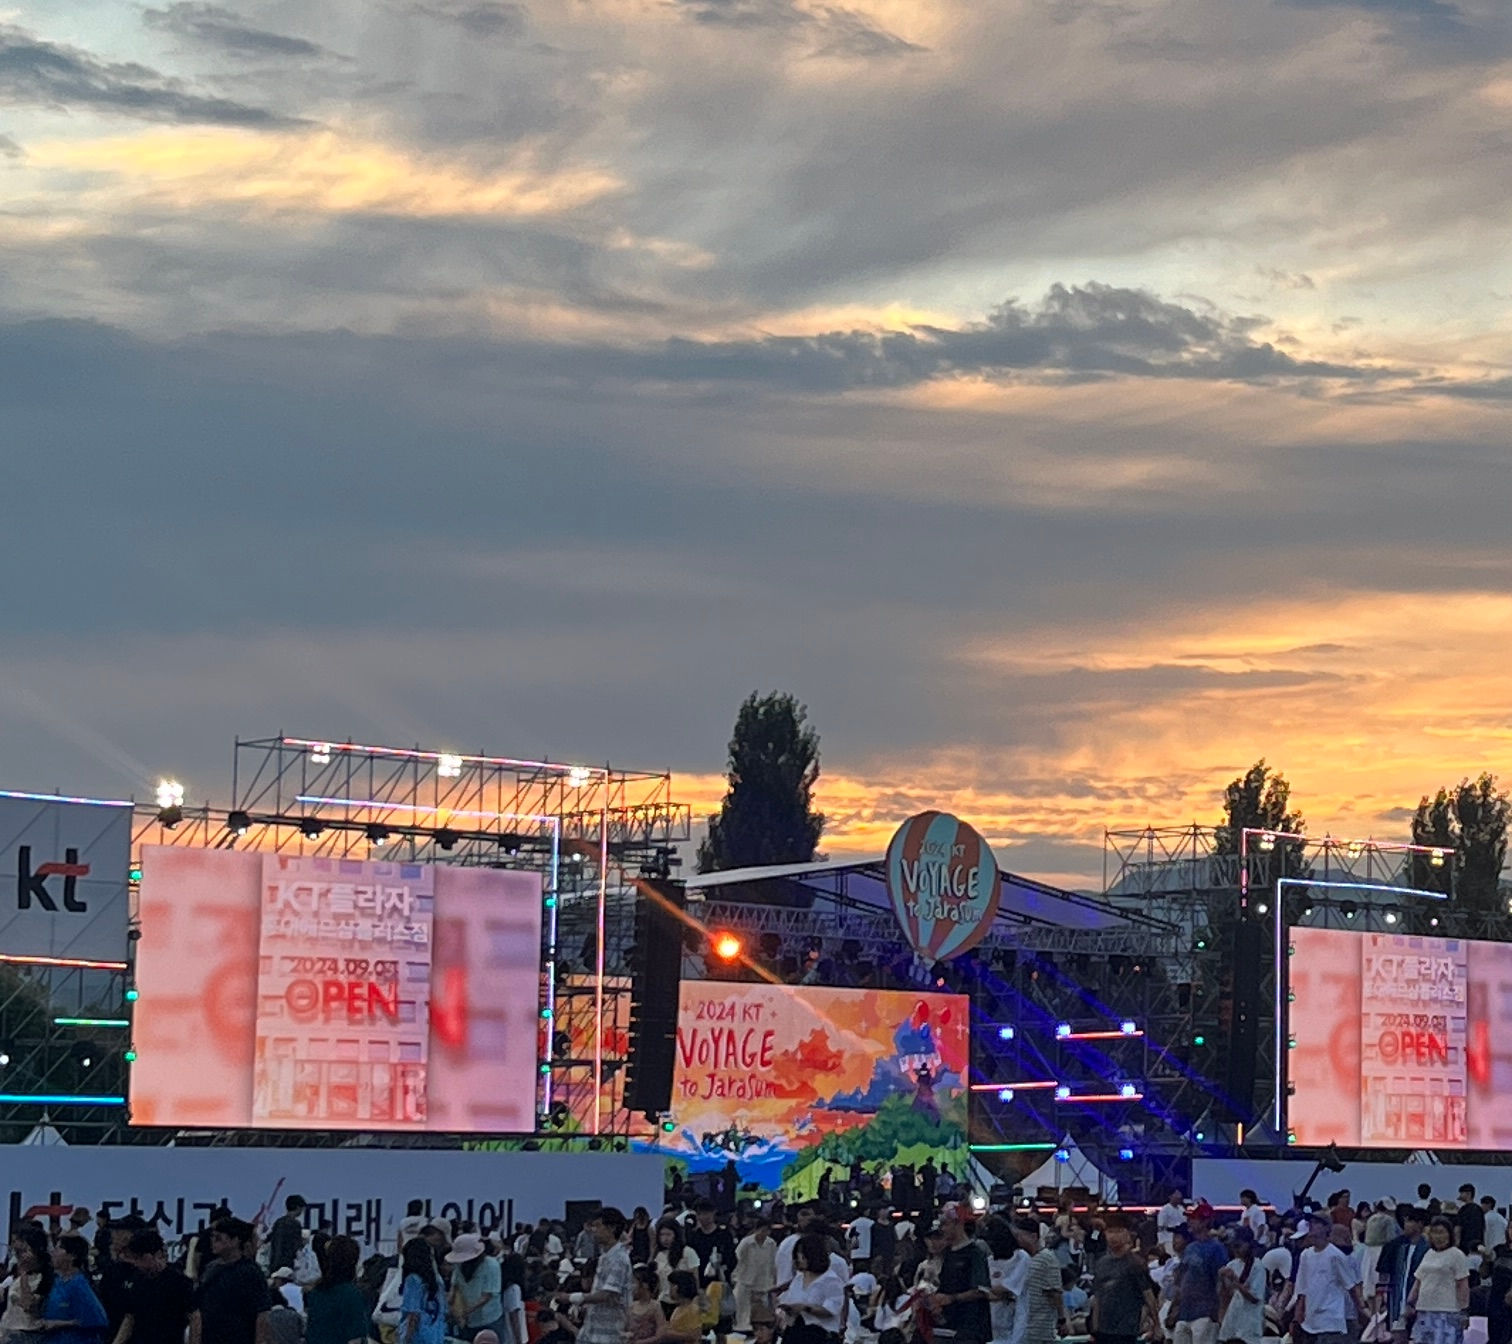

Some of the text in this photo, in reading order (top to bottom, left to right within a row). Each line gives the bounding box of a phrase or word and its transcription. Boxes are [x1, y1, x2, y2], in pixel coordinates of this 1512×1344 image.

[951, 843, 966, 857] KT
[18, 845, 90, 912] kt
[907, 898, 921, 917] to
[285, 979, 398, 1019] OPEN
[696, 1000, 764, 1022] 2024 KT
[1378, 1030, 1448, 1060] OPEN
[681, 1075, 698, 1097] to
[304, 1198, 382, 1244] 미래
